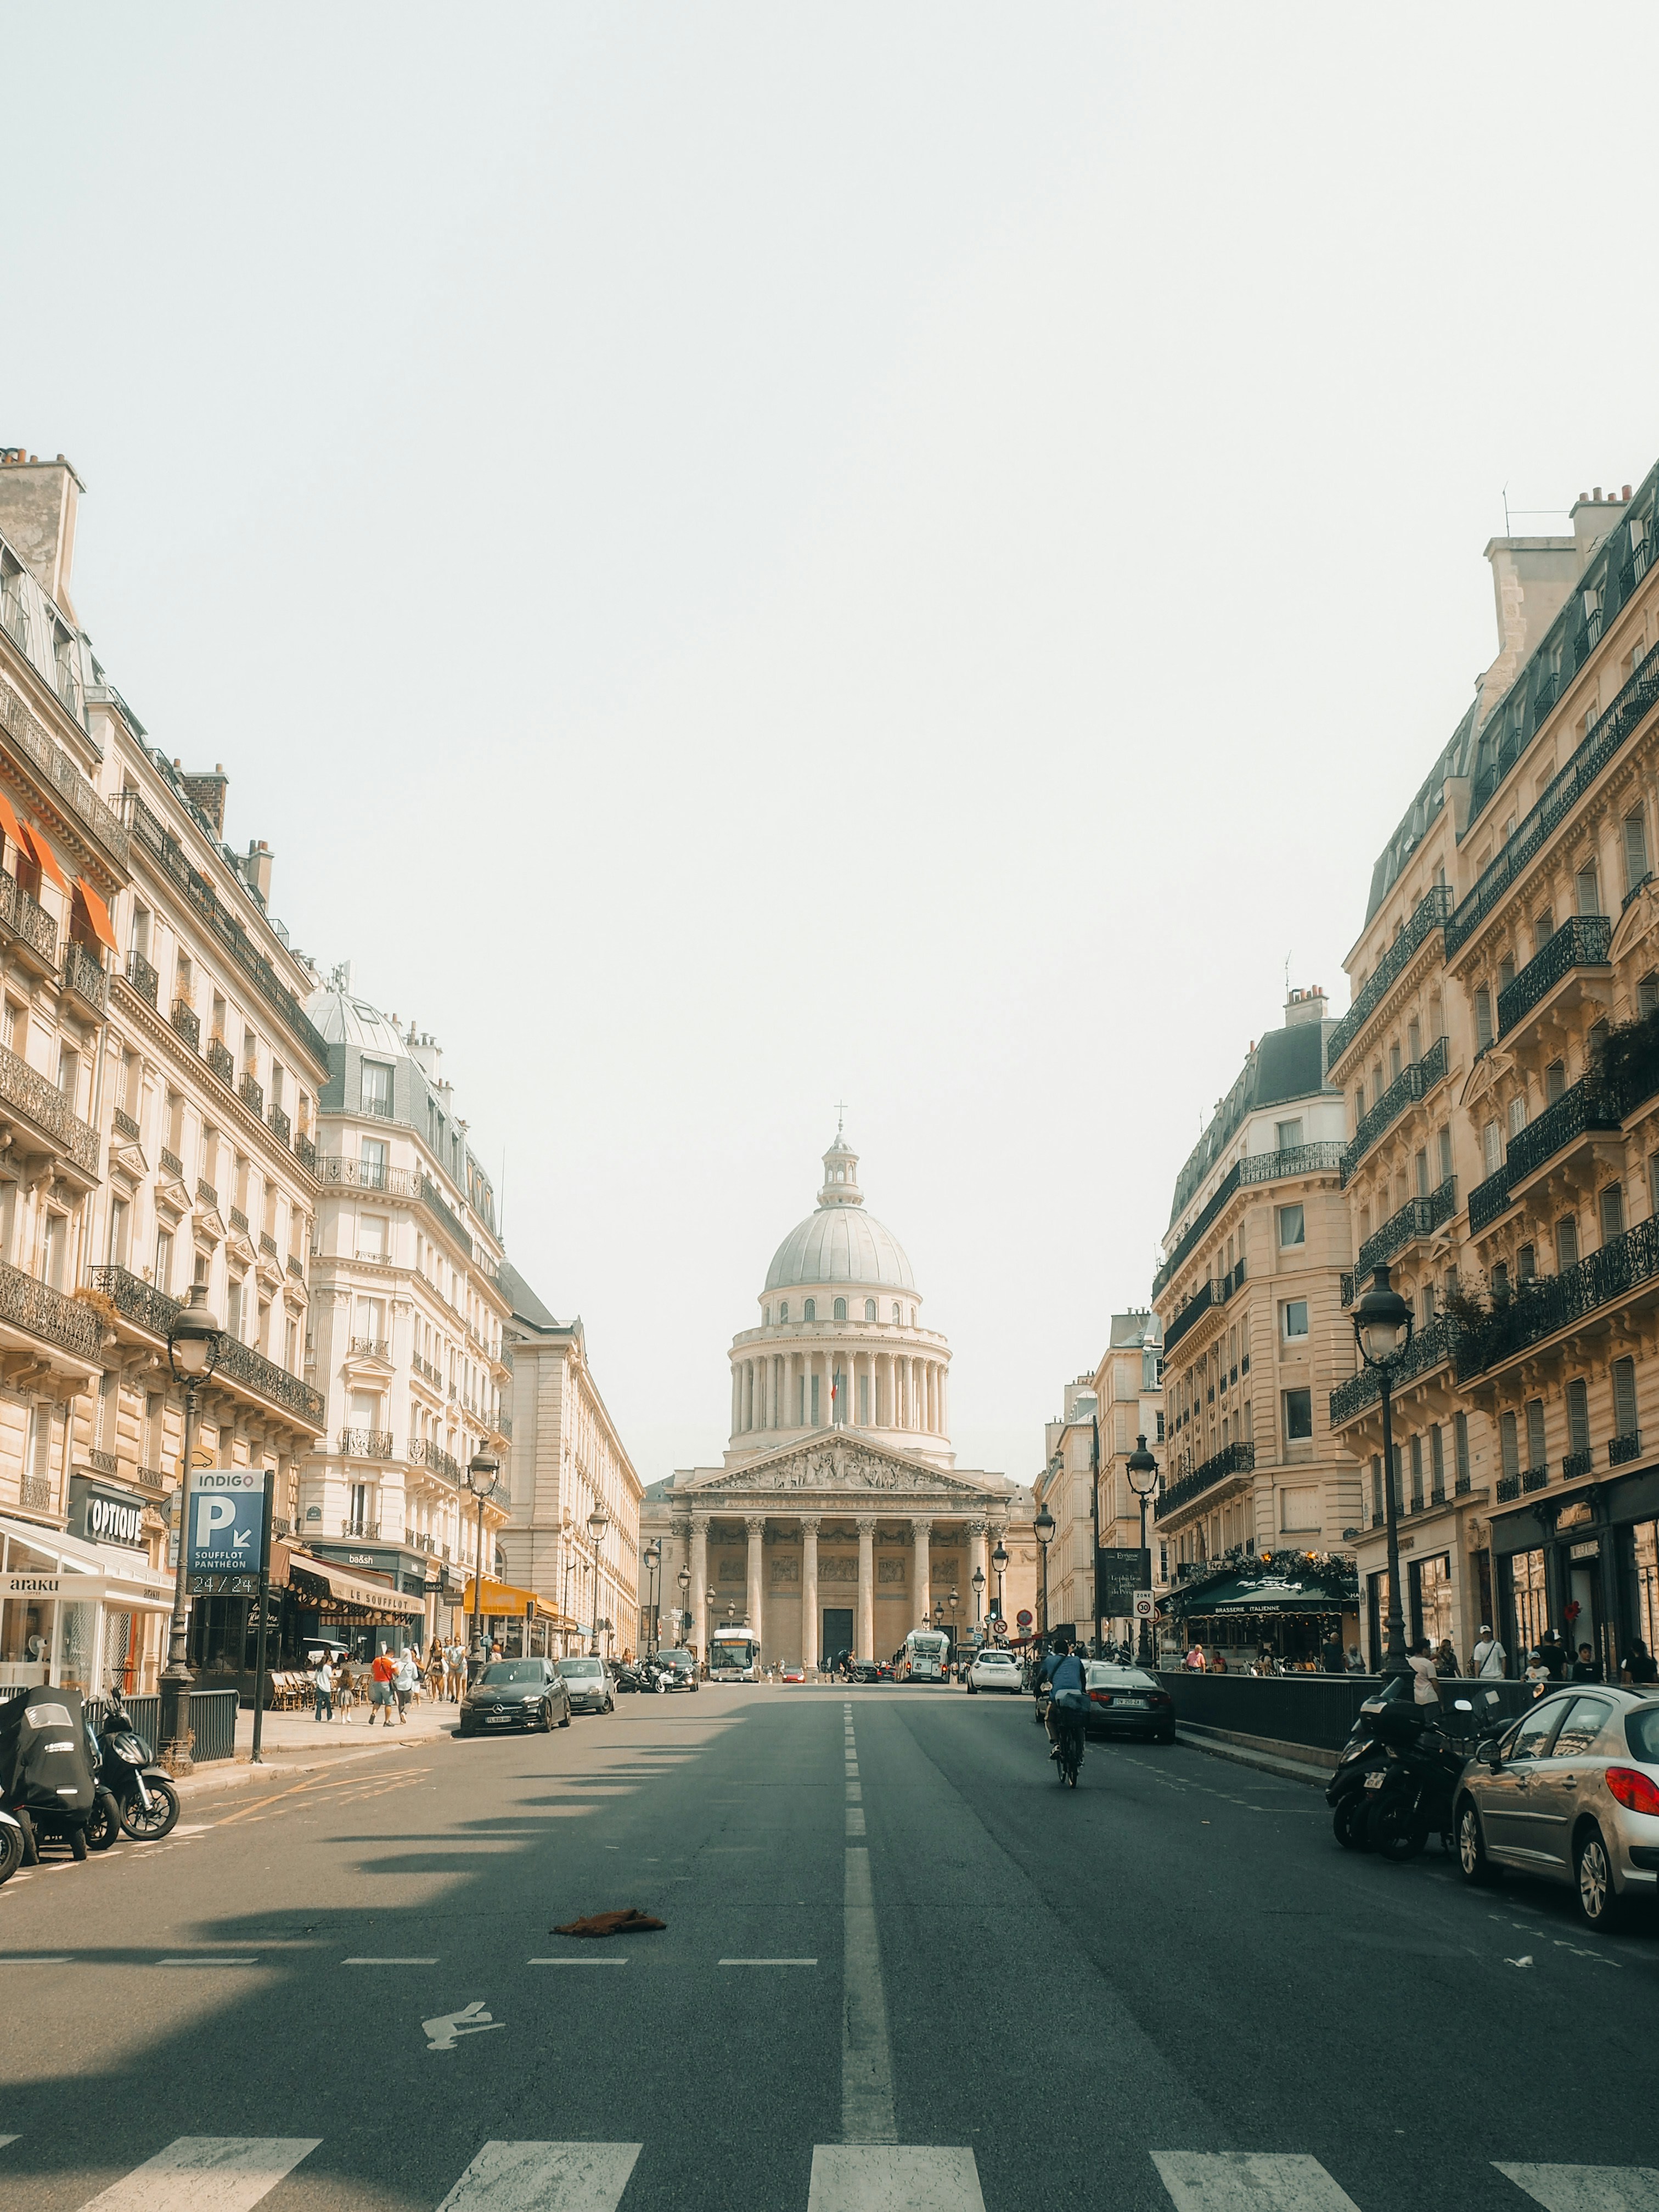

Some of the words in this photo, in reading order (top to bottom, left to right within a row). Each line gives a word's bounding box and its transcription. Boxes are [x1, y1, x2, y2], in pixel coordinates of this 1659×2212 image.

[199, 1475, 254, 1488] INDIGO
[92, 1499, 142, 1541] OPTIQUE
[196, 1495, 237, 1547] P
[195, 1560, 246, 1568] PANTHÉON
[349, 1554, 373, 1564] ba&sh
[10, 1579, 59, 1591] araku
[351, 1589, 361, 1600] LE
[366, 1594, 408, 1609] SOUFFLOT
